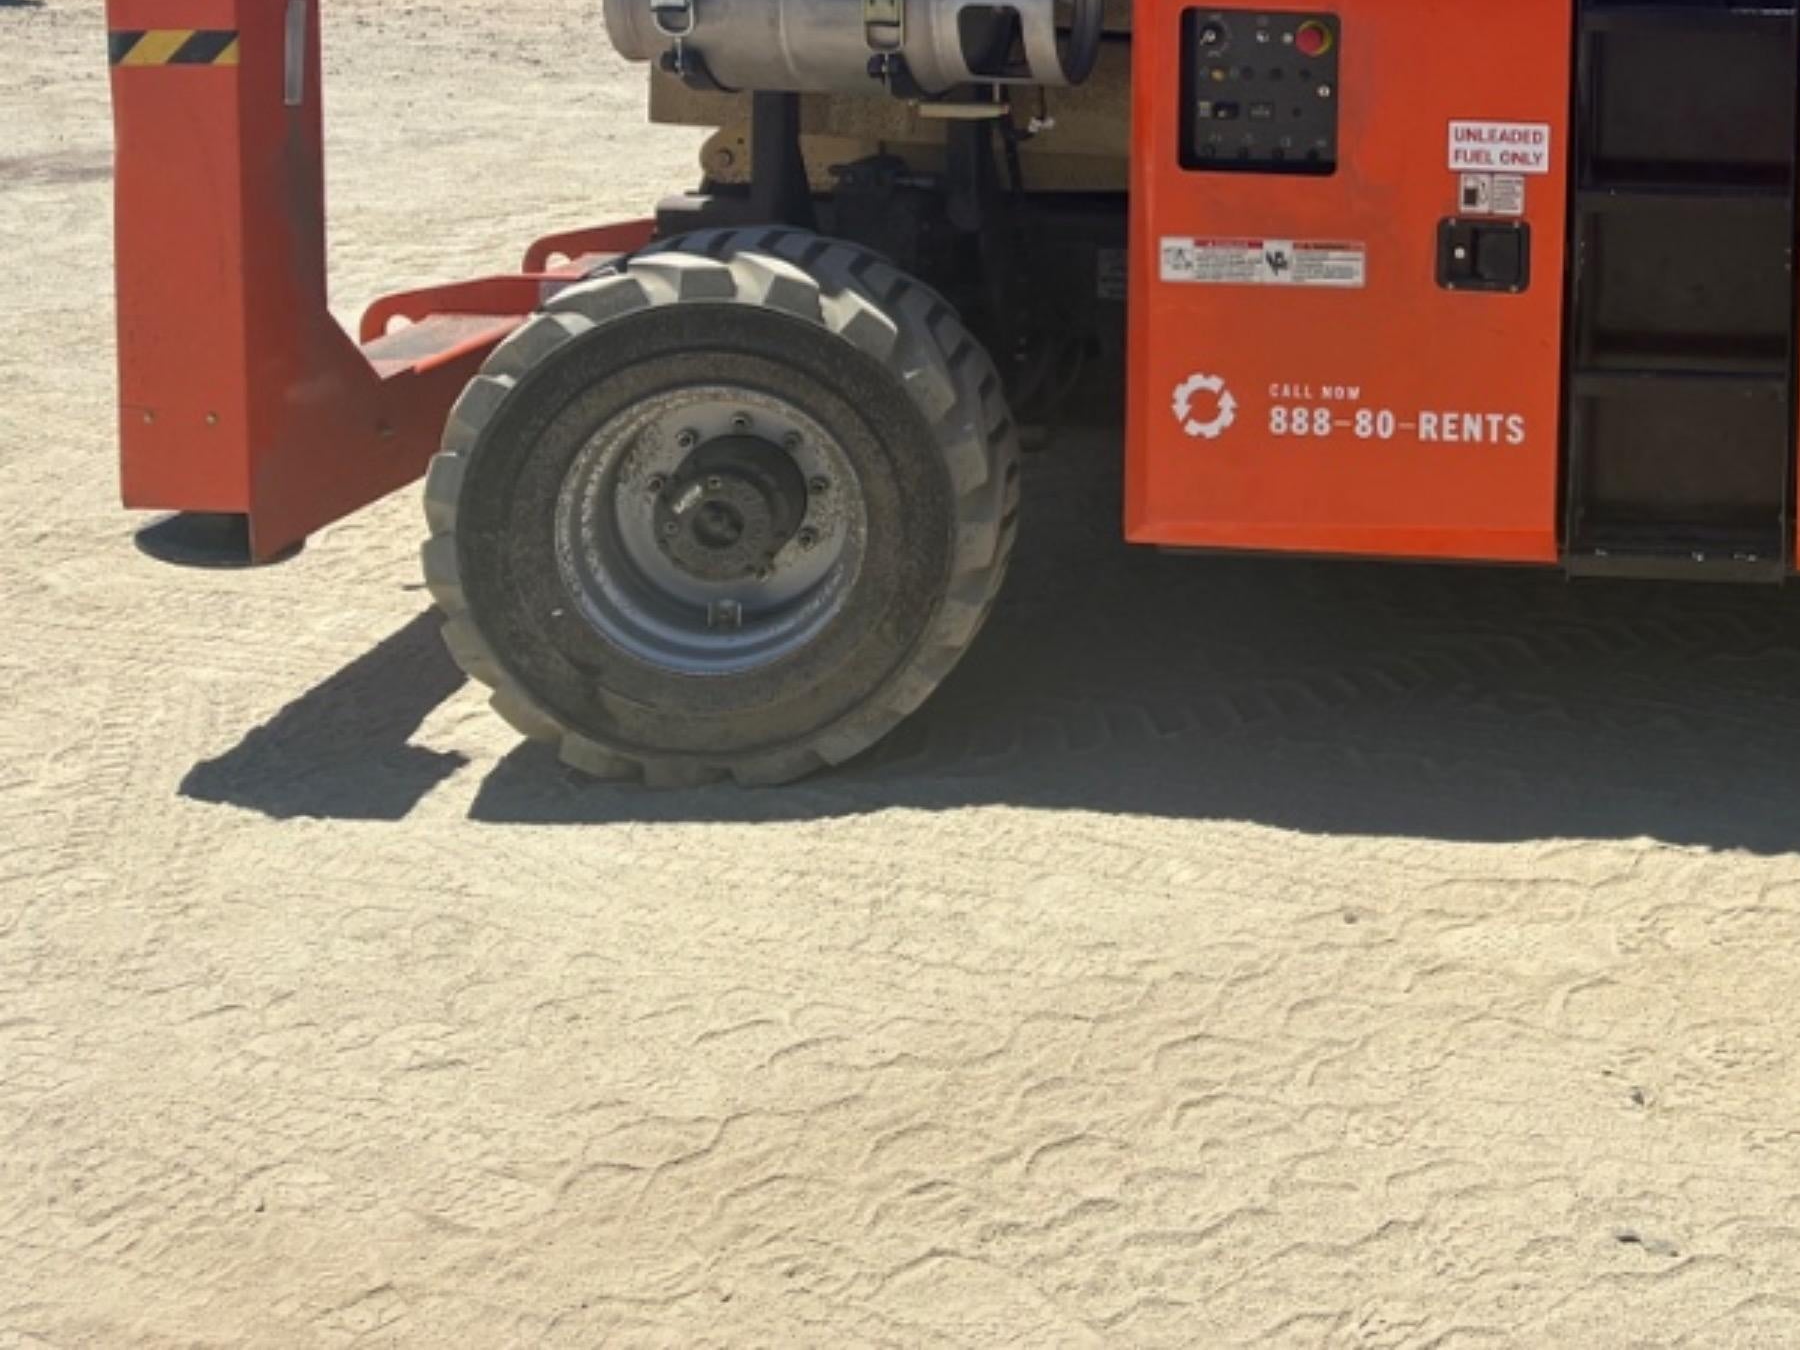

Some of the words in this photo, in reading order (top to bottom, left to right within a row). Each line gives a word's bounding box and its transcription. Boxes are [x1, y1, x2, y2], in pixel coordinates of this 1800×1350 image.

[1454, 126, 1543, 145] UNLEADED
[1454, 149, 1494, 165] FUEL
[1499, 150, 1543, 166] ONLY
[1268, 383, 1313, 399] CALL
[1321, 385, 1361, 400] NOW
[1269, 405, 1526, 446] 888-80-RENTS
